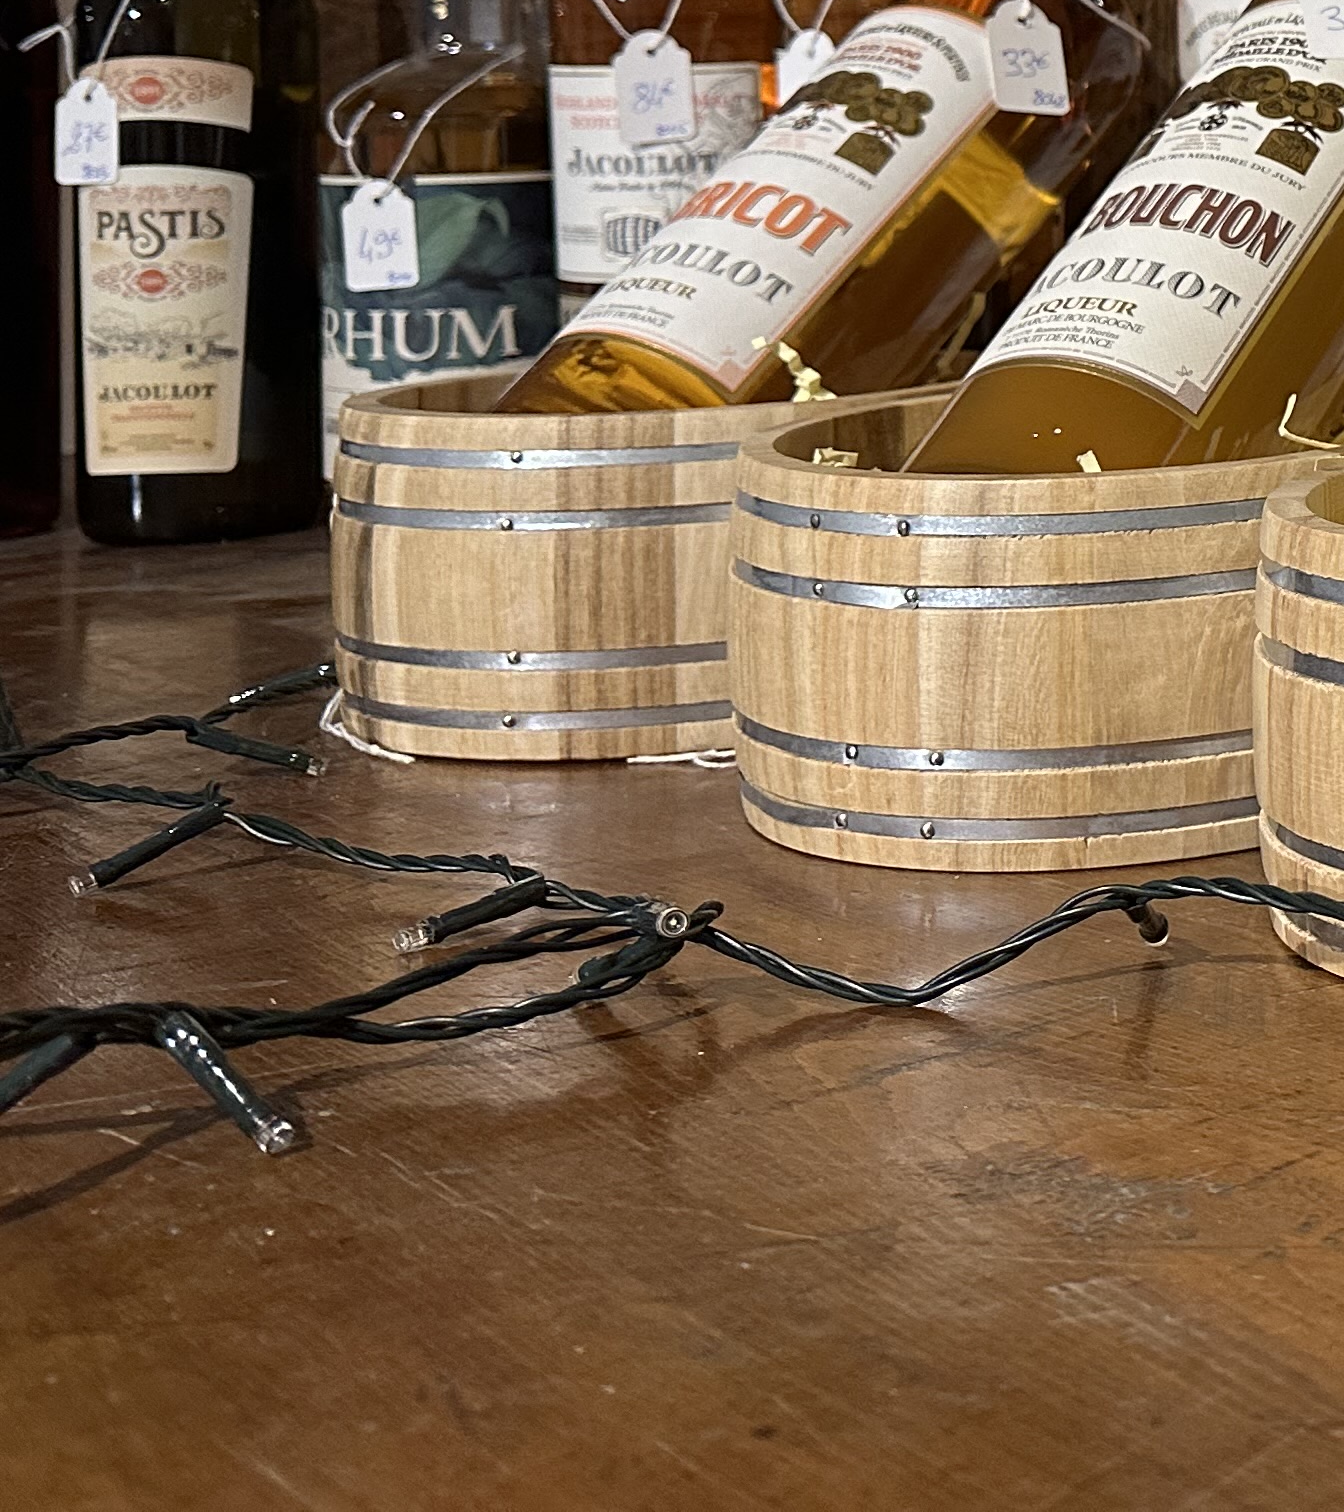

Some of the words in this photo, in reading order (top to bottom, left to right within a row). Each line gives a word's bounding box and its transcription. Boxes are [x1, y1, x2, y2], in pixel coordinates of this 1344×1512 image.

[1187, 152, 1249, 167] MEMBRE
[1250, 162, 1272, 176] DU
[1272, 172, 1307, 191] JURY
[97, 209, 225, 259] PASTIS
[1023, 296, 1138, 319] LIQUEUR
[1030, 257, 1242, 319] ACOULOT
[323, 304, 523, 363] RHUM
[98, 383, 217, 403] JACOULOT
